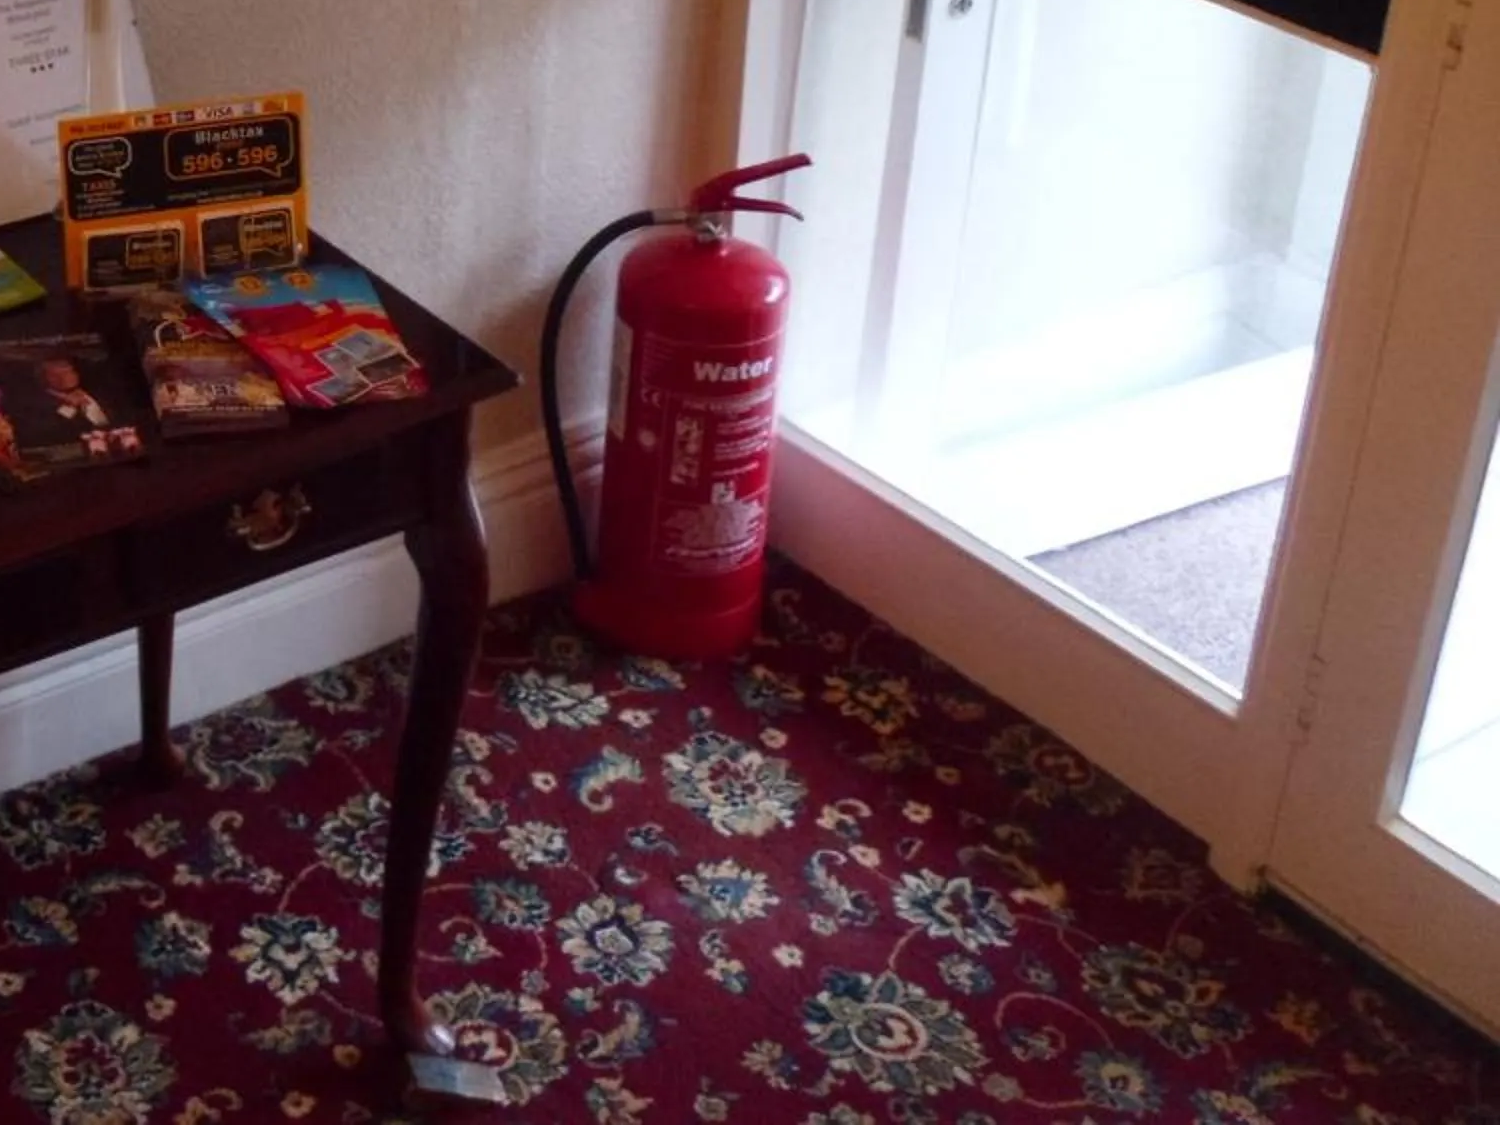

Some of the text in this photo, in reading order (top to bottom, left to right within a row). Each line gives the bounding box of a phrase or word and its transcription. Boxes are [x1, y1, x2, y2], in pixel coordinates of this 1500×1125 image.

[204, 105, 234, 119] VISA
[181, 144, 278, 174] 596 596
[693, 356, 773, 382] Water
